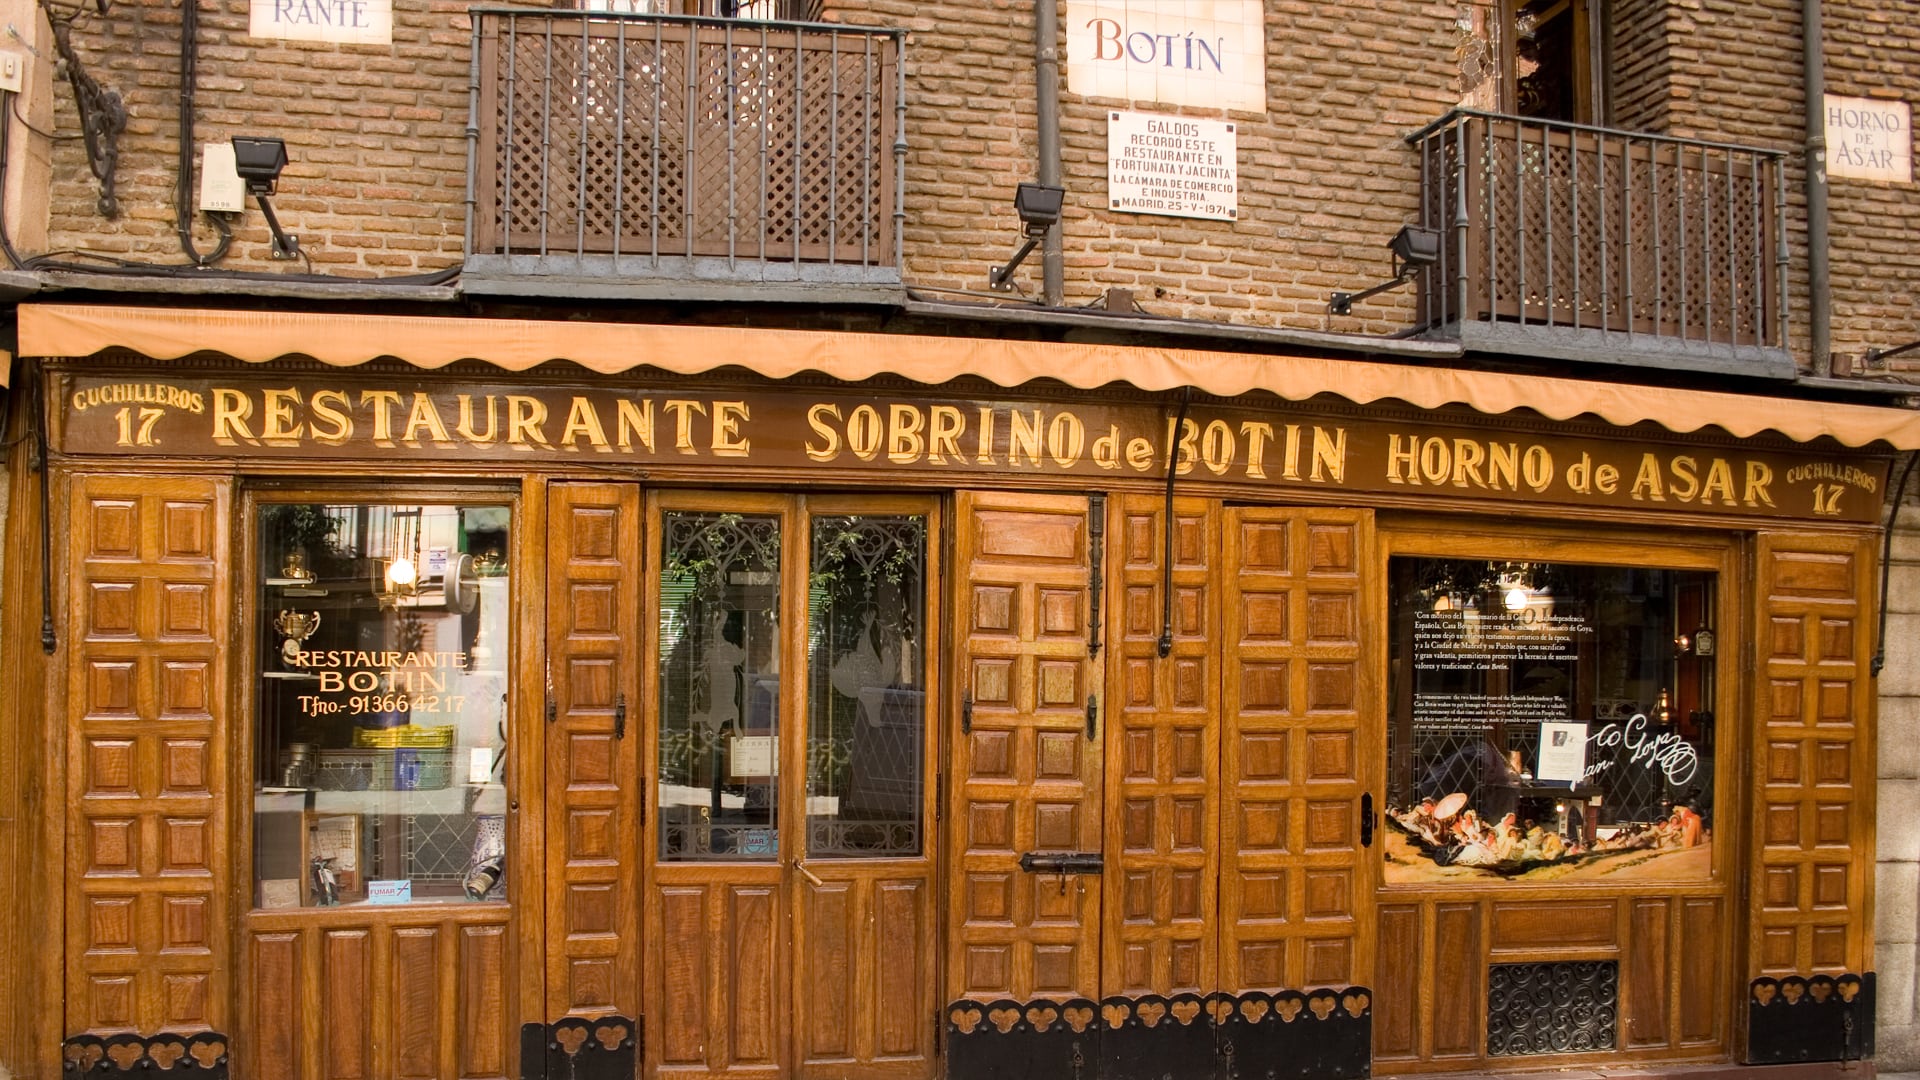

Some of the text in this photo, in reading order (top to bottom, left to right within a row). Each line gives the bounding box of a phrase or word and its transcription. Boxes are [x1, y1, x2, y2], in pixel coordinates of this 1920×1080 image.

[274, 0, 369, 28] RANTE
[1148, 120, 1199, 137] GALDOS
[1829, 107, 1900, 132] HORNO
[1186, 140, 1216, 152] ESTE
[1856, 133, 1874, 145] DE
[1124, 147, 1222, 166] RESTAURANTE EN
[1836, 140, 1894, 170] ASAR
[1178, 165, 1184, 175] Y
[1114, 174, 1126, 184] LA
[1170, 180, 1182, 188] DE
[1184, 180, 1233, 193] COMERCIO
[1142, 188, 1148, 196] E
[74, 384, 204, 414] CUCHILLEROS
[212, 387, 1776, 508] RESTAURANTE SOBRINO de BOTIN HORNO de ASAR
[1786, 462, 1878, 494] CUCHILLEROS
[296, 650, 468, 668] RESTAURANTE
[320, 671, 446, 692] BOTIN
